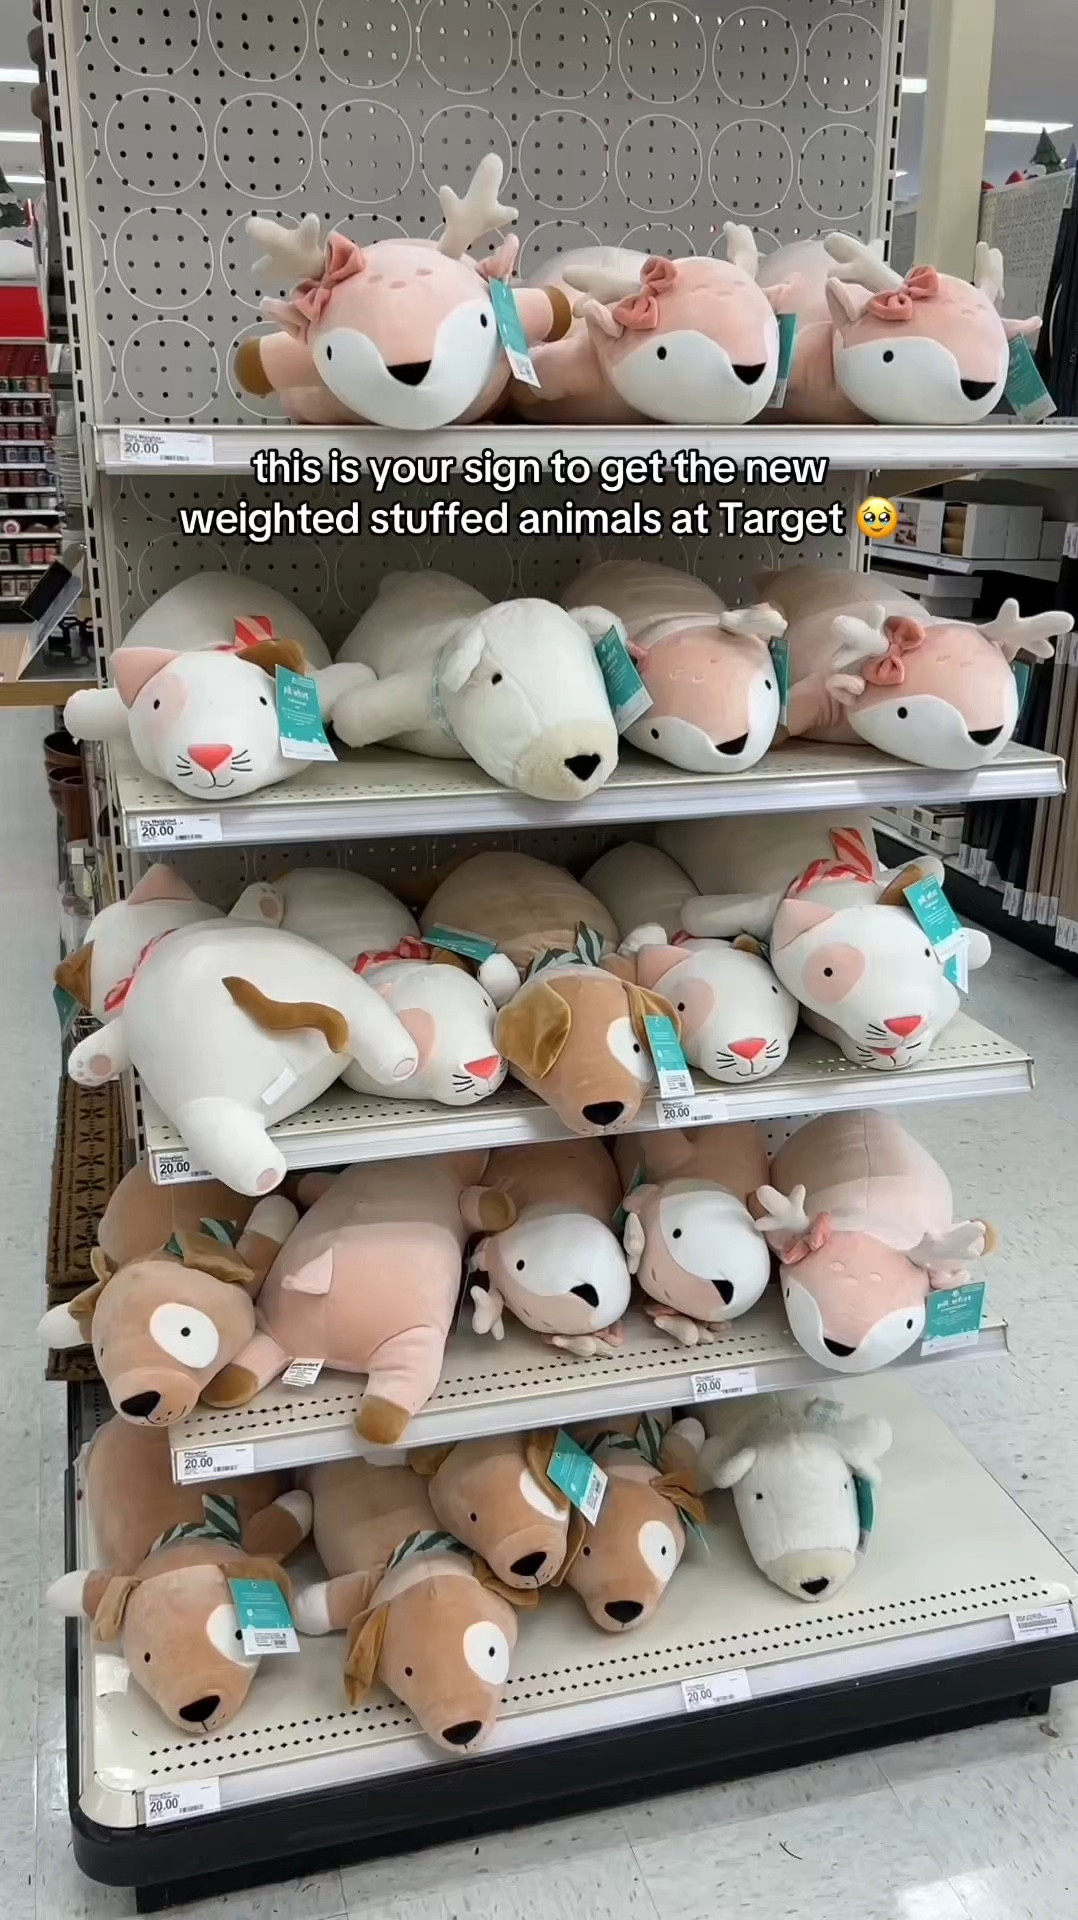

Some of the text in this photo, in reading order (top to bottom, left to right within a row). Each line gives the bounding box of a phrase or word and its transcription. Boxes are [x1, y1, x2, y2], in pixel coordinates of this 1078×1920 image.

[124, 443, 159, 454] 20.00
[142, 825, 174, 838] 20.00
[663, 1107, 690, 1120] 20.00
[160, 1161, 190, 1175] 20.00
[696, 1380, 721, 1393] 20.00
[184, 1456, 213, 1469] 20.00
[688, 1688, 712, 1702] 20.00
[150, 1797, 178, 1813] 20.00
